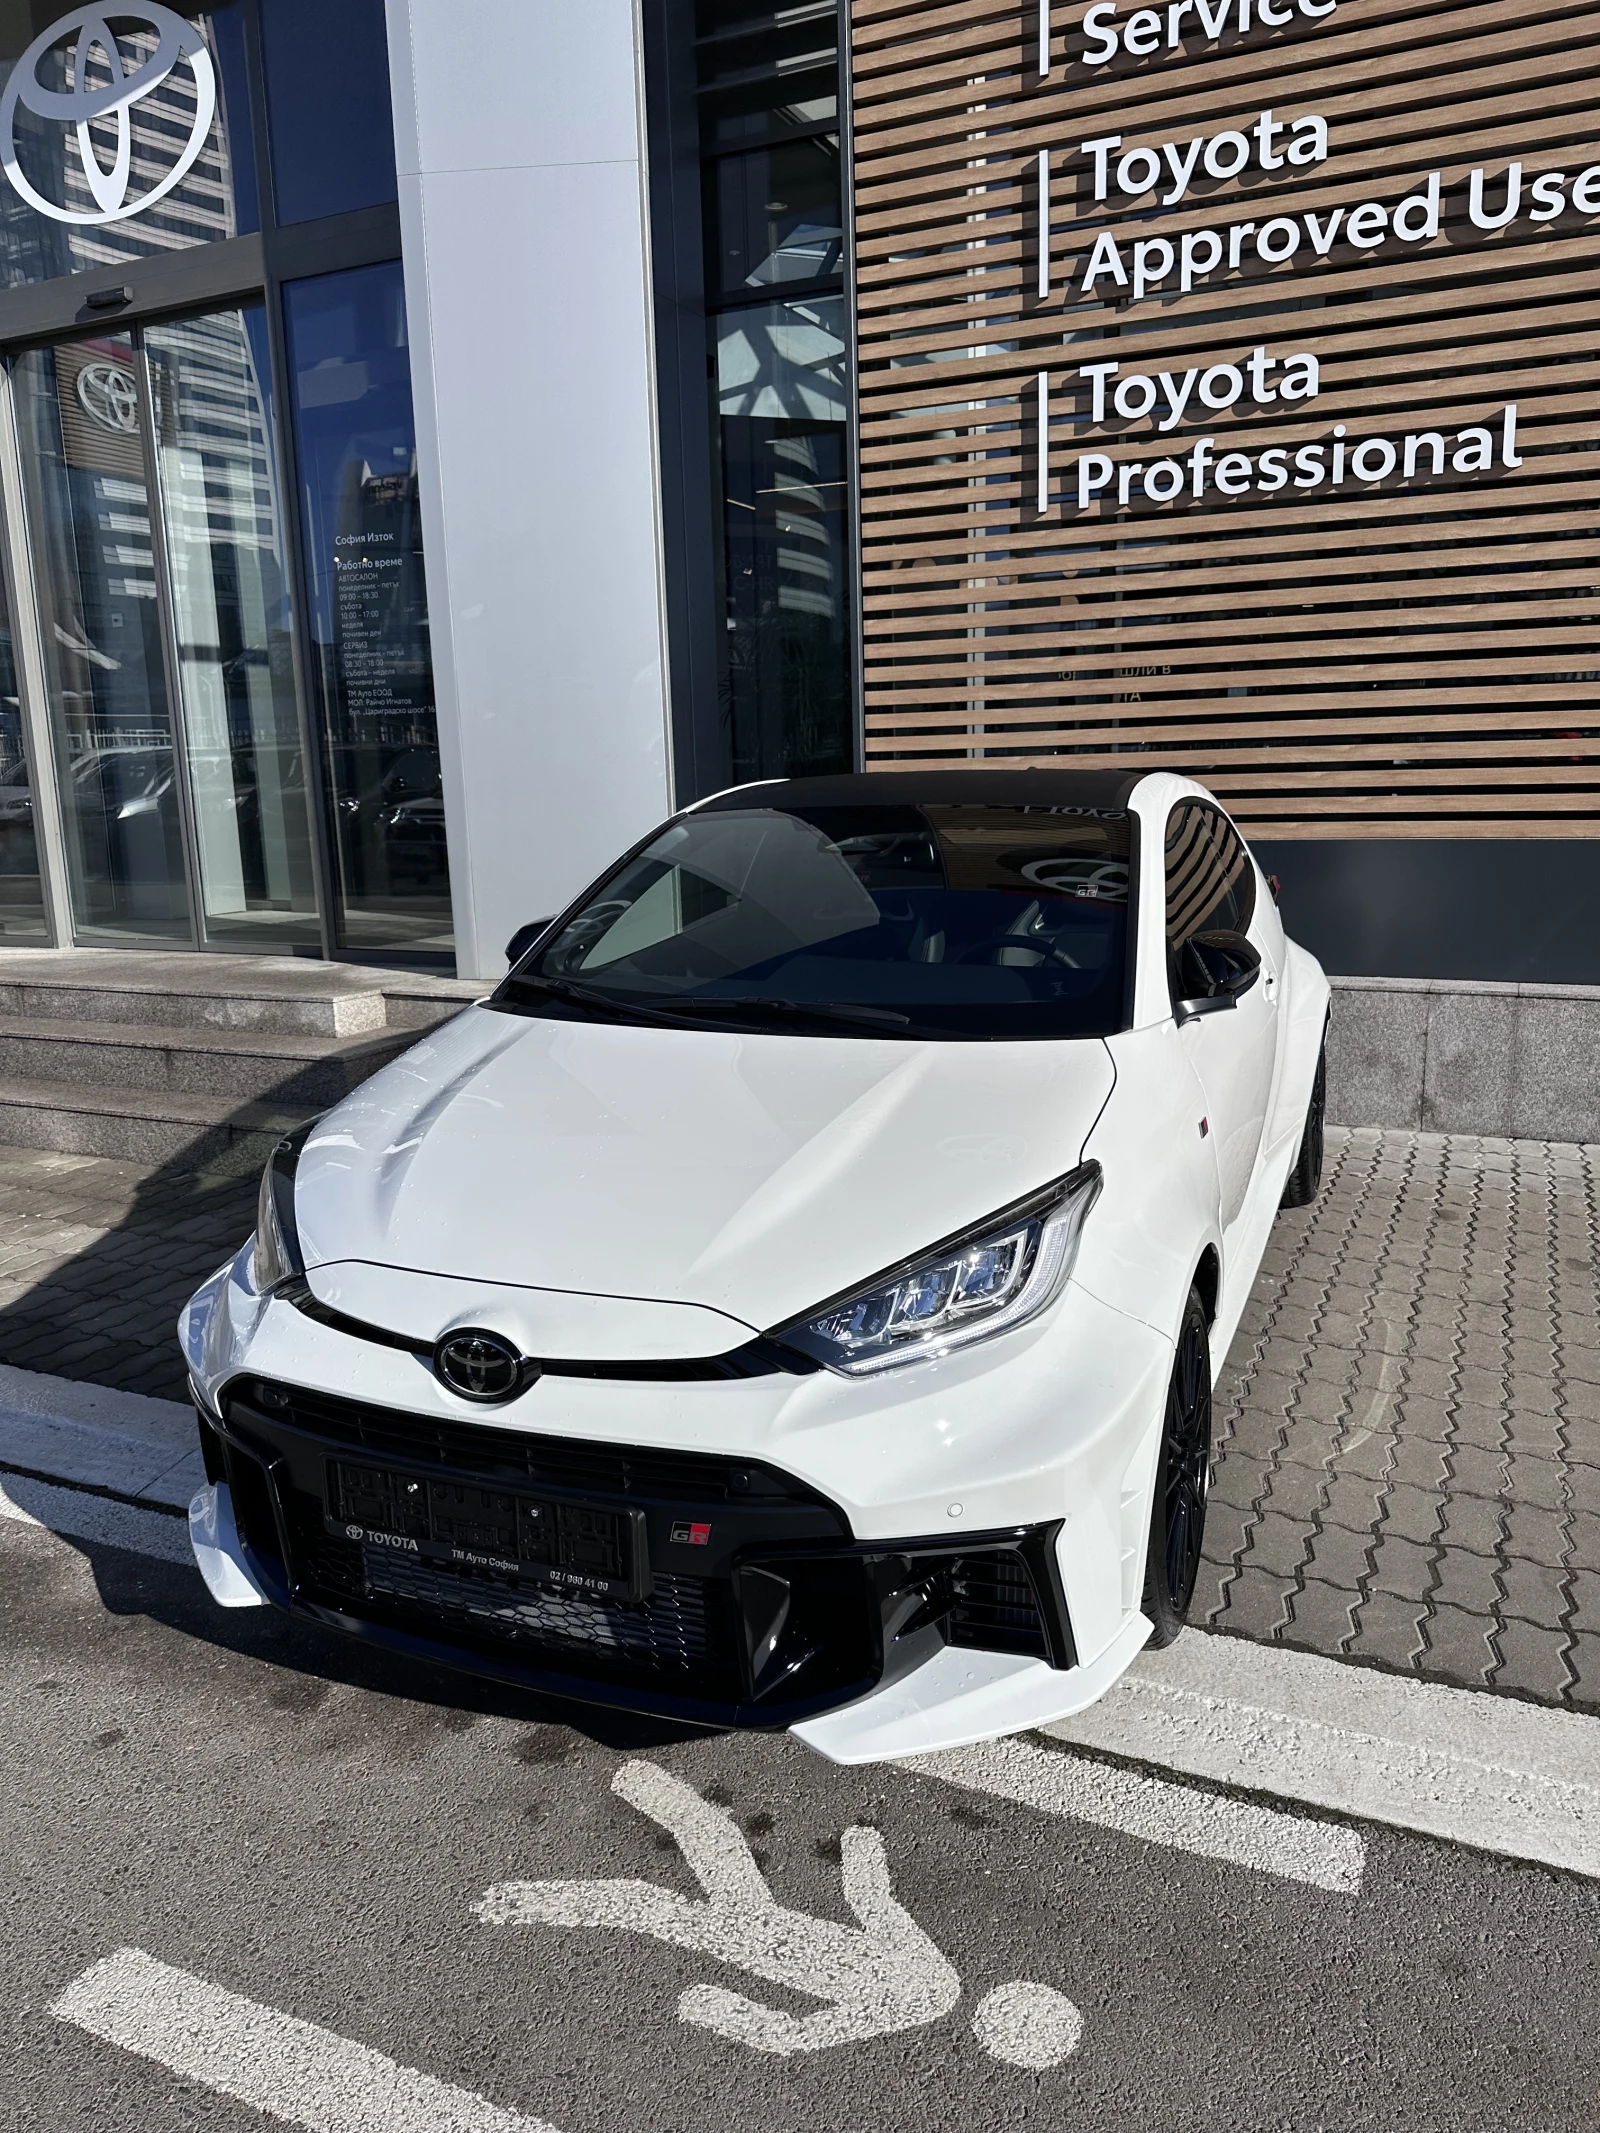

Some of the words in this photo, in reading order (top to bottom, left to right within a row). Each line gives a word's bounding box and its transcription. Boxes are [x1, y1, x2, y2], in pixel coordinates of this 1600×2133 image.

[1080, 109, 1330, 206] Toyota
[1080, 173, 1441, 300] Approved
[1468, 161, 1600, 230] Use
[1078, 346, 1321, 432] Toyota
[1077, 403, 1524, 509] Professional
[335, 534, 366, 546] София
[367, 532, 395, 543] Изток
[337, 560, 373, 571] Работно
[374, 558, 403, 570] време
[339, 572, 379, 583] АВТОСАЛОН
[339, 584, 377, 592] понеделник
[340, 593, 357, 602] 09:00
[340, 603, 363, 611] събота
[341, 612, 357, 620] 10:00
[363, 610, 380, 619] 17:00
[341, 622, 364, 630] неделя
[342, 631, 369, 639] почивен
[369, 630, 382, 638] ден
[343, 641, 368, 650] СЕРВИЗ
[344, 660, 362, 668] 08:30
[367, 659, 384, 668] 18:00
[345, 670, 368, 678] събота
[372, 669, 396, 677] неделя
[346, 679, 373, 687] почивни
[374, 679, 387, 687] дни
[347, 690, 357, 698] ТМ
[358, 689, 373, 700] Ауто
[372, 688, 393, 698] ЕООД
[385, 698, 412, 706] Игнатов
[428, 705, 437, 714] 16
[366, 1530, 419, 1551] TOYOTA
[672, 1529, 707, 1544] GR
[452, 1549, 465, 1560] ТМ
[466, 1552, 488, 1567] Ауто
[488, 1557, 520, 1572] София
[550, 1570, 561, 1581] 02
[584, 1578, 595, 1588] 41
[597, 1581, 609, 1591] 00
